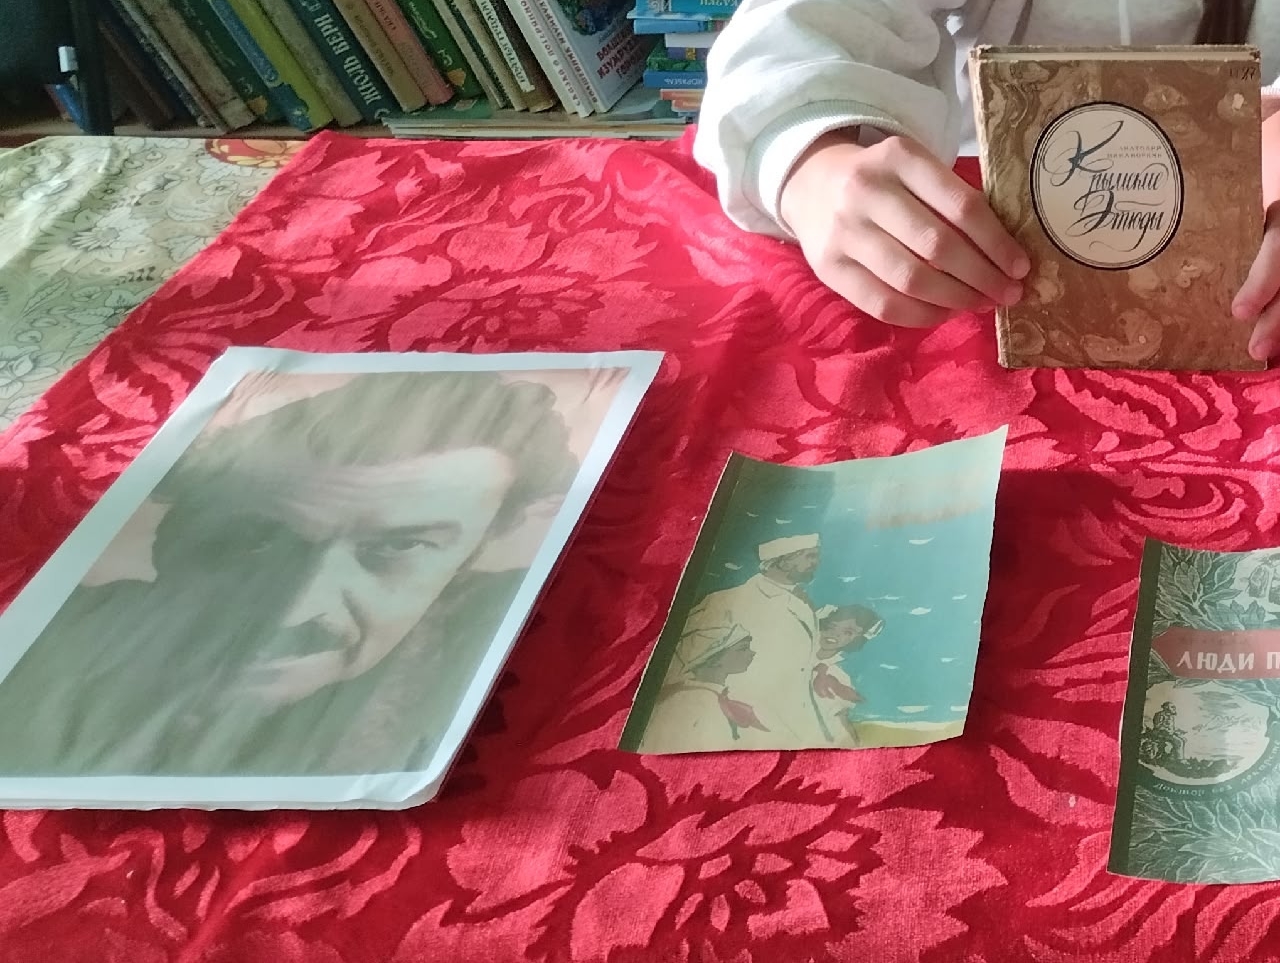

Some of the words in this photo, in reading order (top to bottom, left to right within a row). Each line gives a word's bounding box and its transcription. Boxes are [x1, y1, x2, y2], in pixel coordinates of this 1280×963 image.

[311, 10, 352, 57] ВЕРН
[338, 53, 385, 107] ЖЮЛЬ
[1176, 651, 1255, 674] ЛЮДИ
